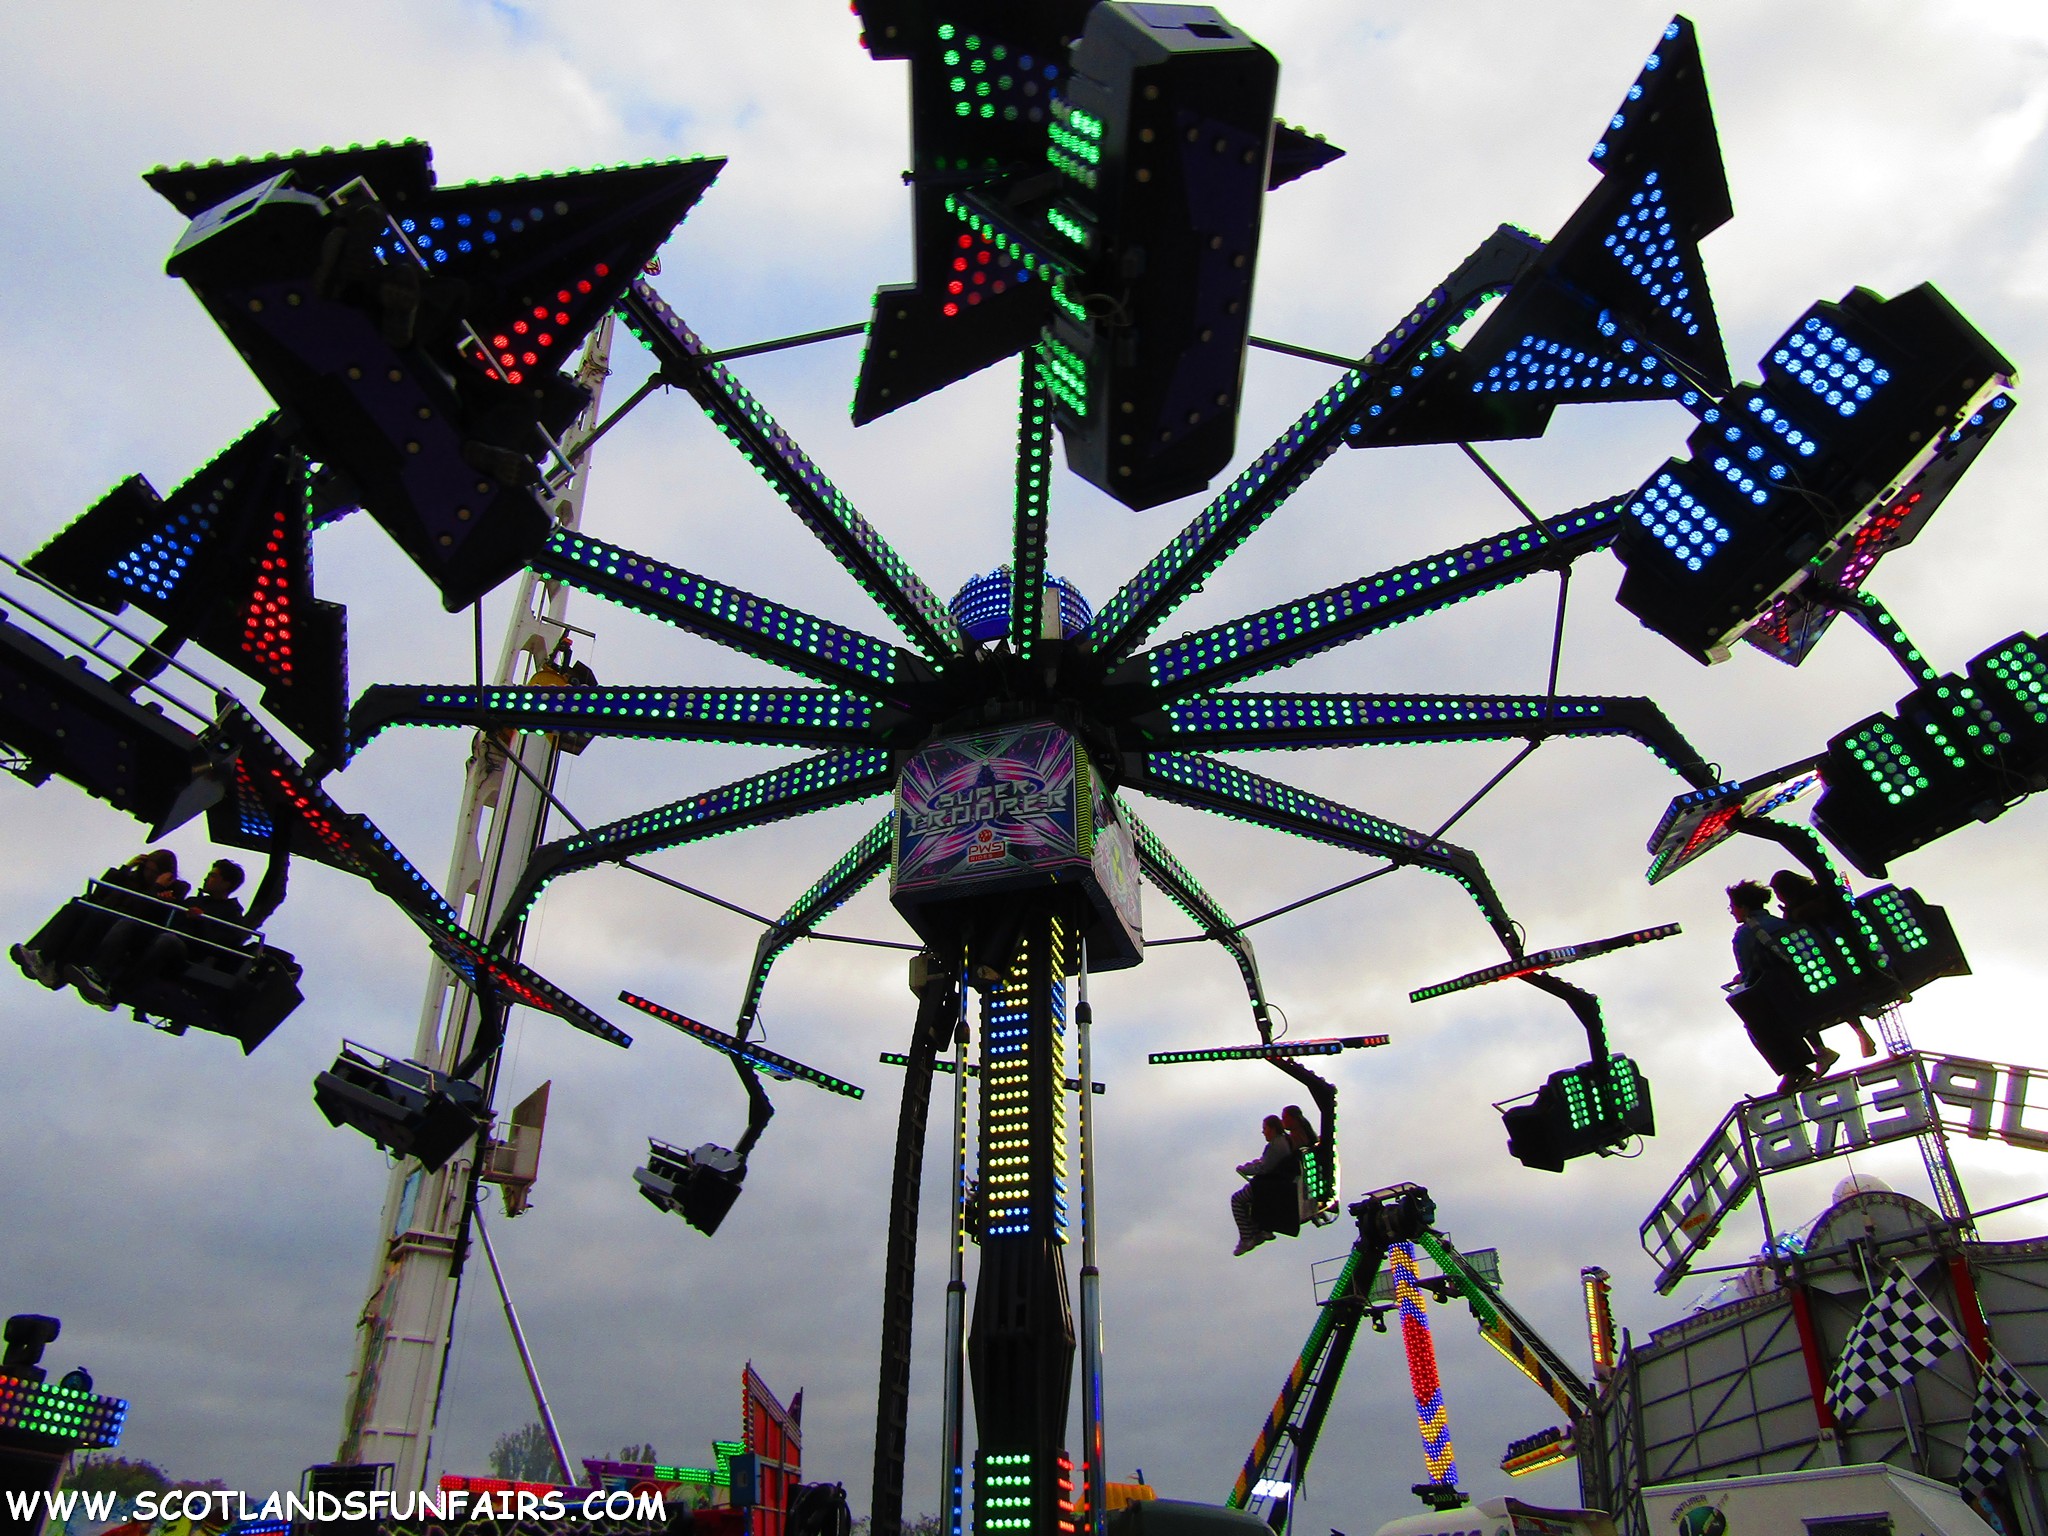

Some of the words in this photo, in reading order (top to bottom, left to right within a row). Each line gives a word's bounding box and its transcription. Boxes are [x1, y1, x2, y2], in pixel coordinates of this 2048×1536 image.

[936, 779, 1030, 808] SUPER
[969, 841, 1003, 855] PWS
[970, 854, 993, 862] RIDES
